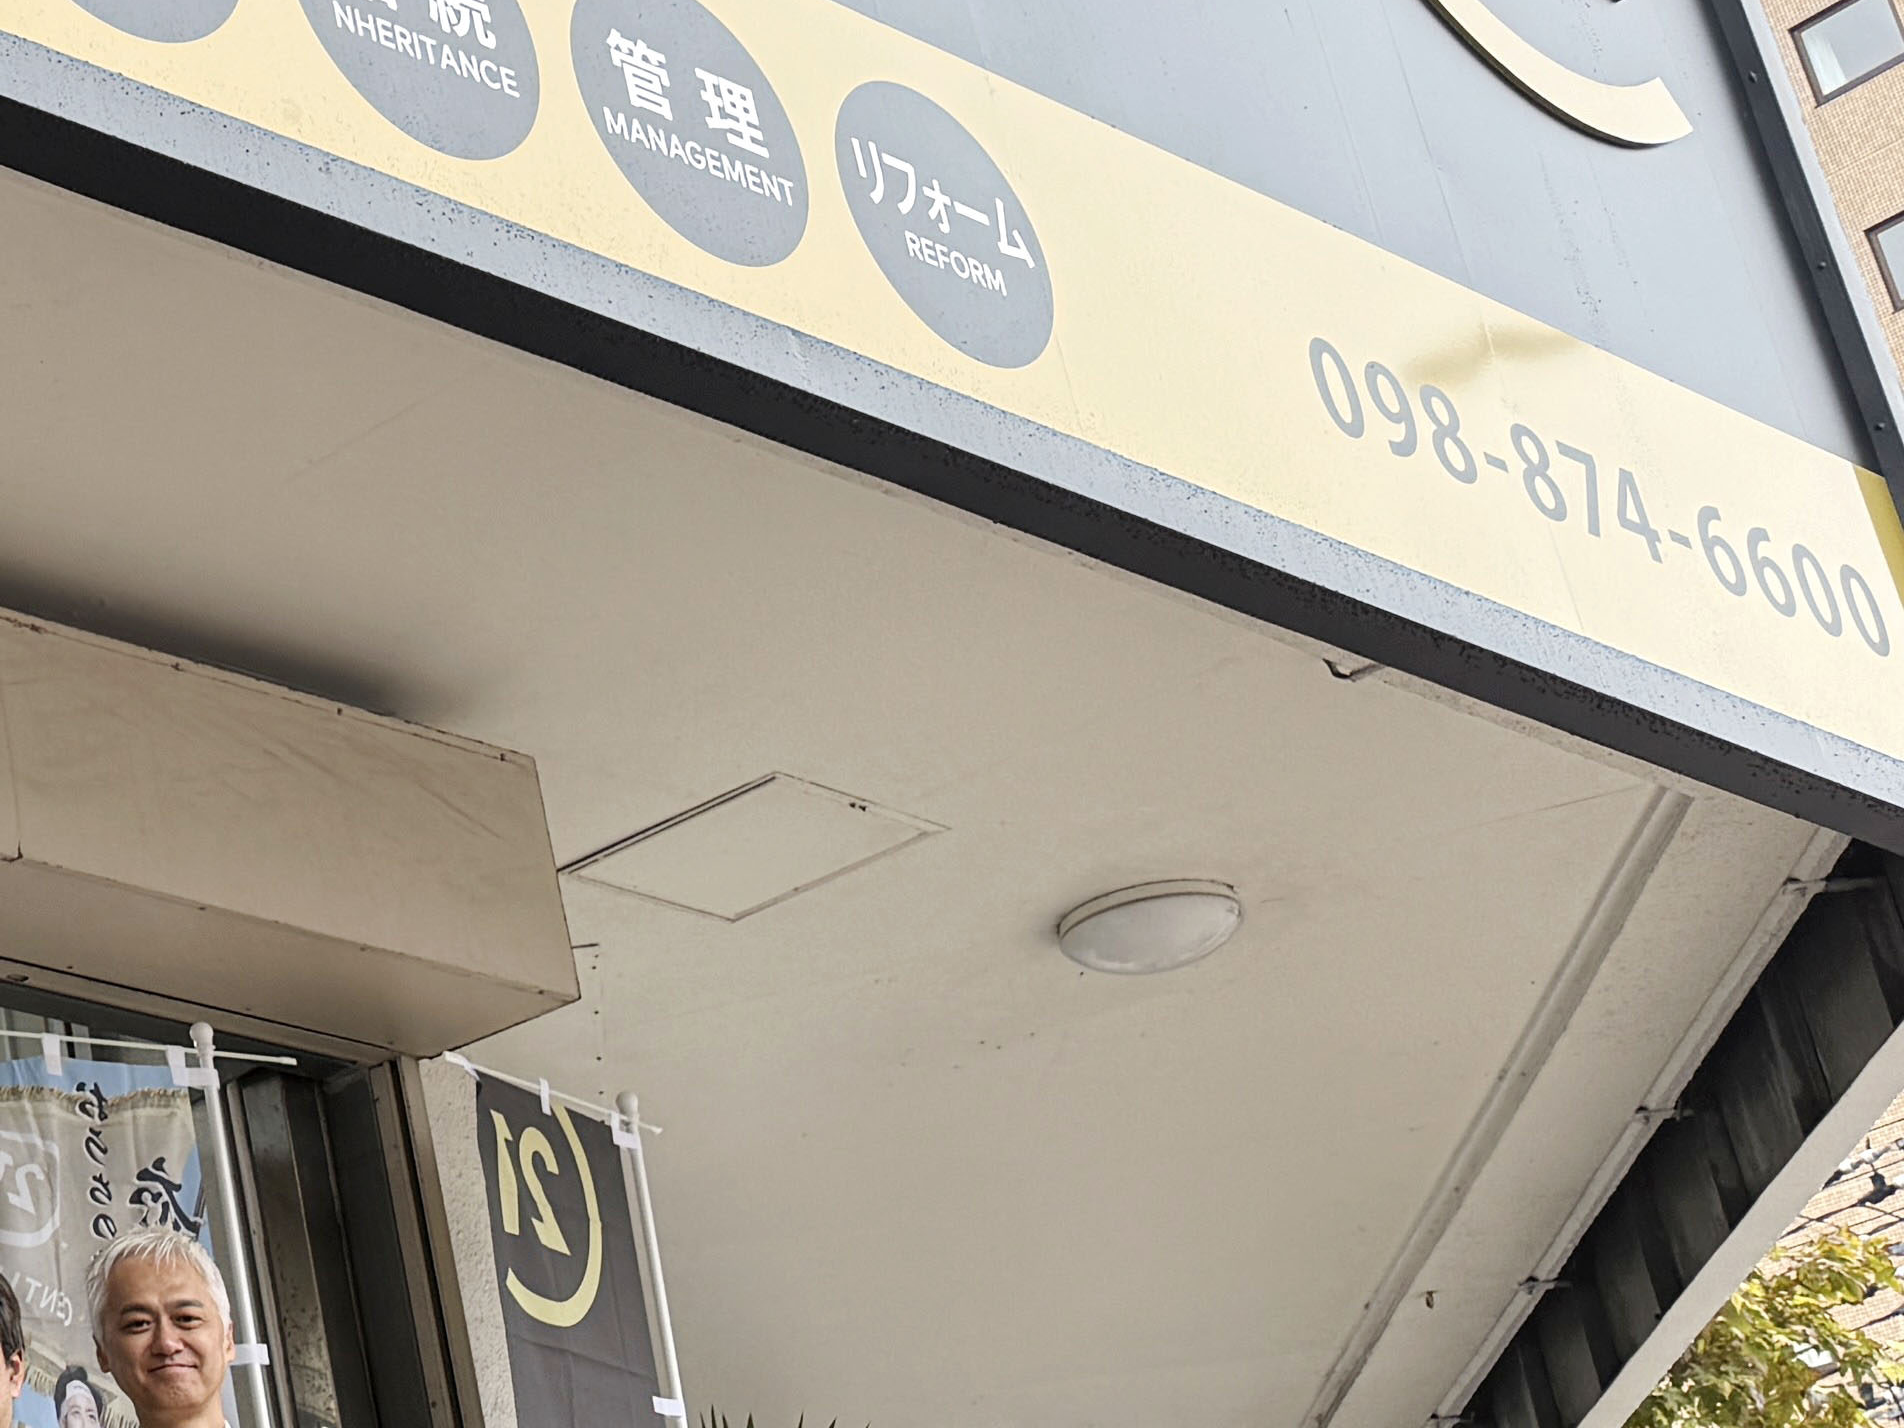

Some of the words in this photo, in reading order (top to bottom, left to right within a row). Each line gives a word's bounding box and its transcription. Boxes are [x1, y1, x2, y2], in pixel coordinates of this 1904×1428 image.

[603, 105, 795, 208] MANAGEMENT
[850, 136, 1036, 270] リフォーム
[903, 229, 1008, 297] REFORM
[1307, 335, 1892, 658] 098-874-6600
